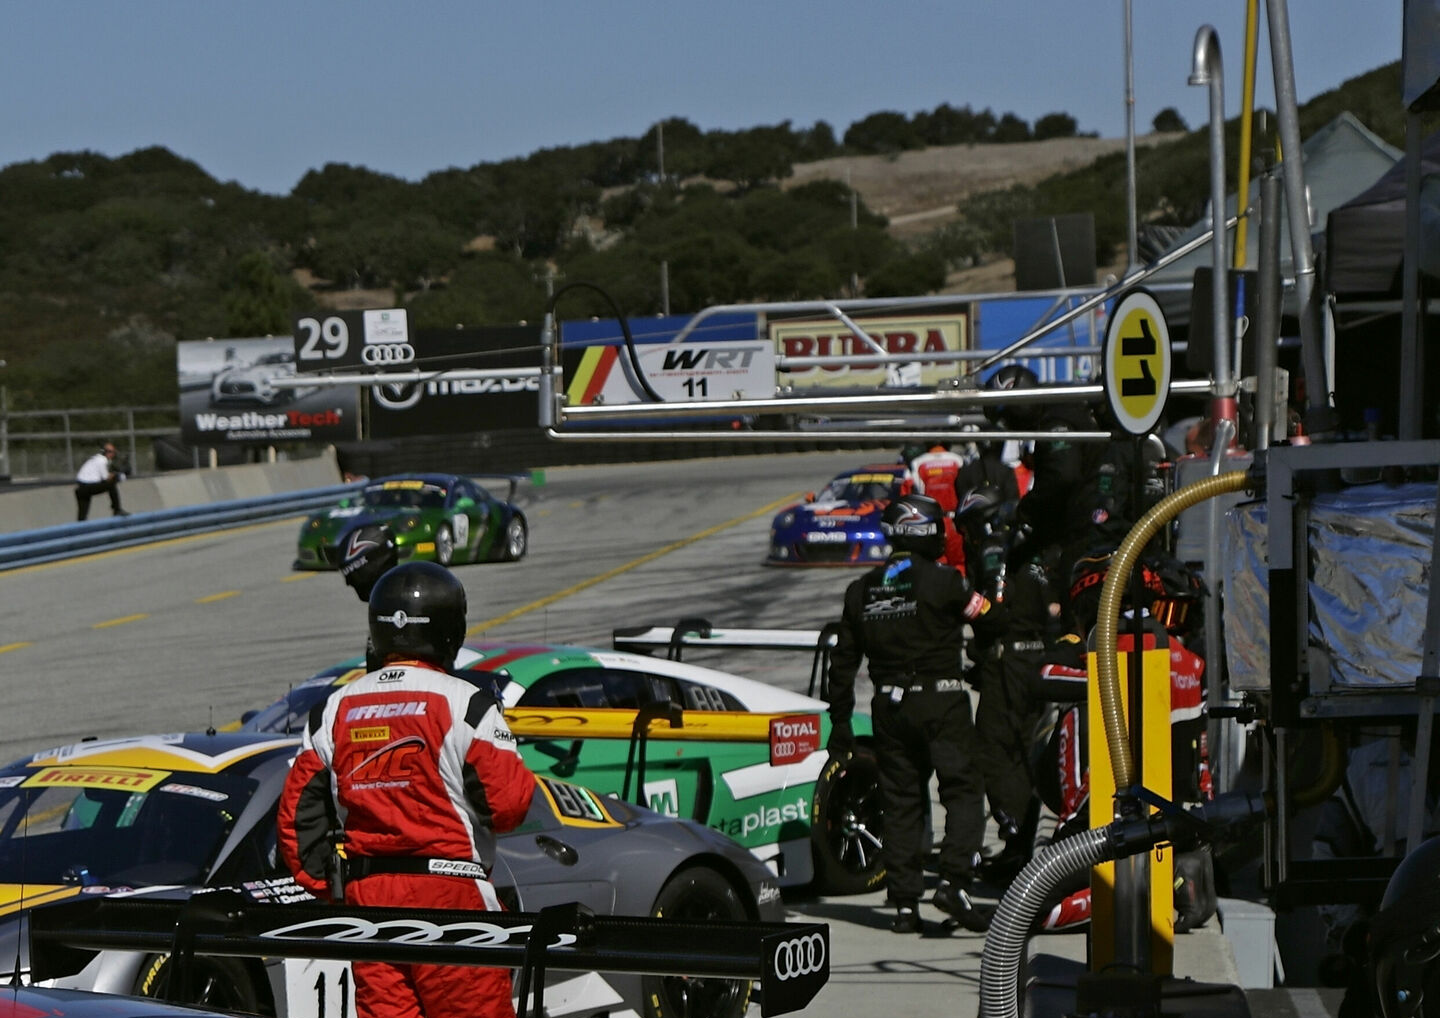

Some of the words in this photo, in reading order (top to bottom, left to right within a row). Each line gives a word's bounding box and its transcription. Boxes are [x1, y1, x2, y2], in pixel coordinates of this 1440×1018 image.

[297, 317, 349, 361] 29
[662, 346, 764, 370] WRT
[1121, 318, 1157, 397] 11
[682, 377, 708, 397] 11
[196, 409, 341, 432] WeatherTech
[341, 555, 368, 577] uvex
[379, 671, 405, 681] OMP
[346, 702, 427, 723] OFFICIAL
[773, 721, 818, 738] TOTAL
[38, 770, 154, 787] PIRELLI
[712, 797, 809, 838] taplast
